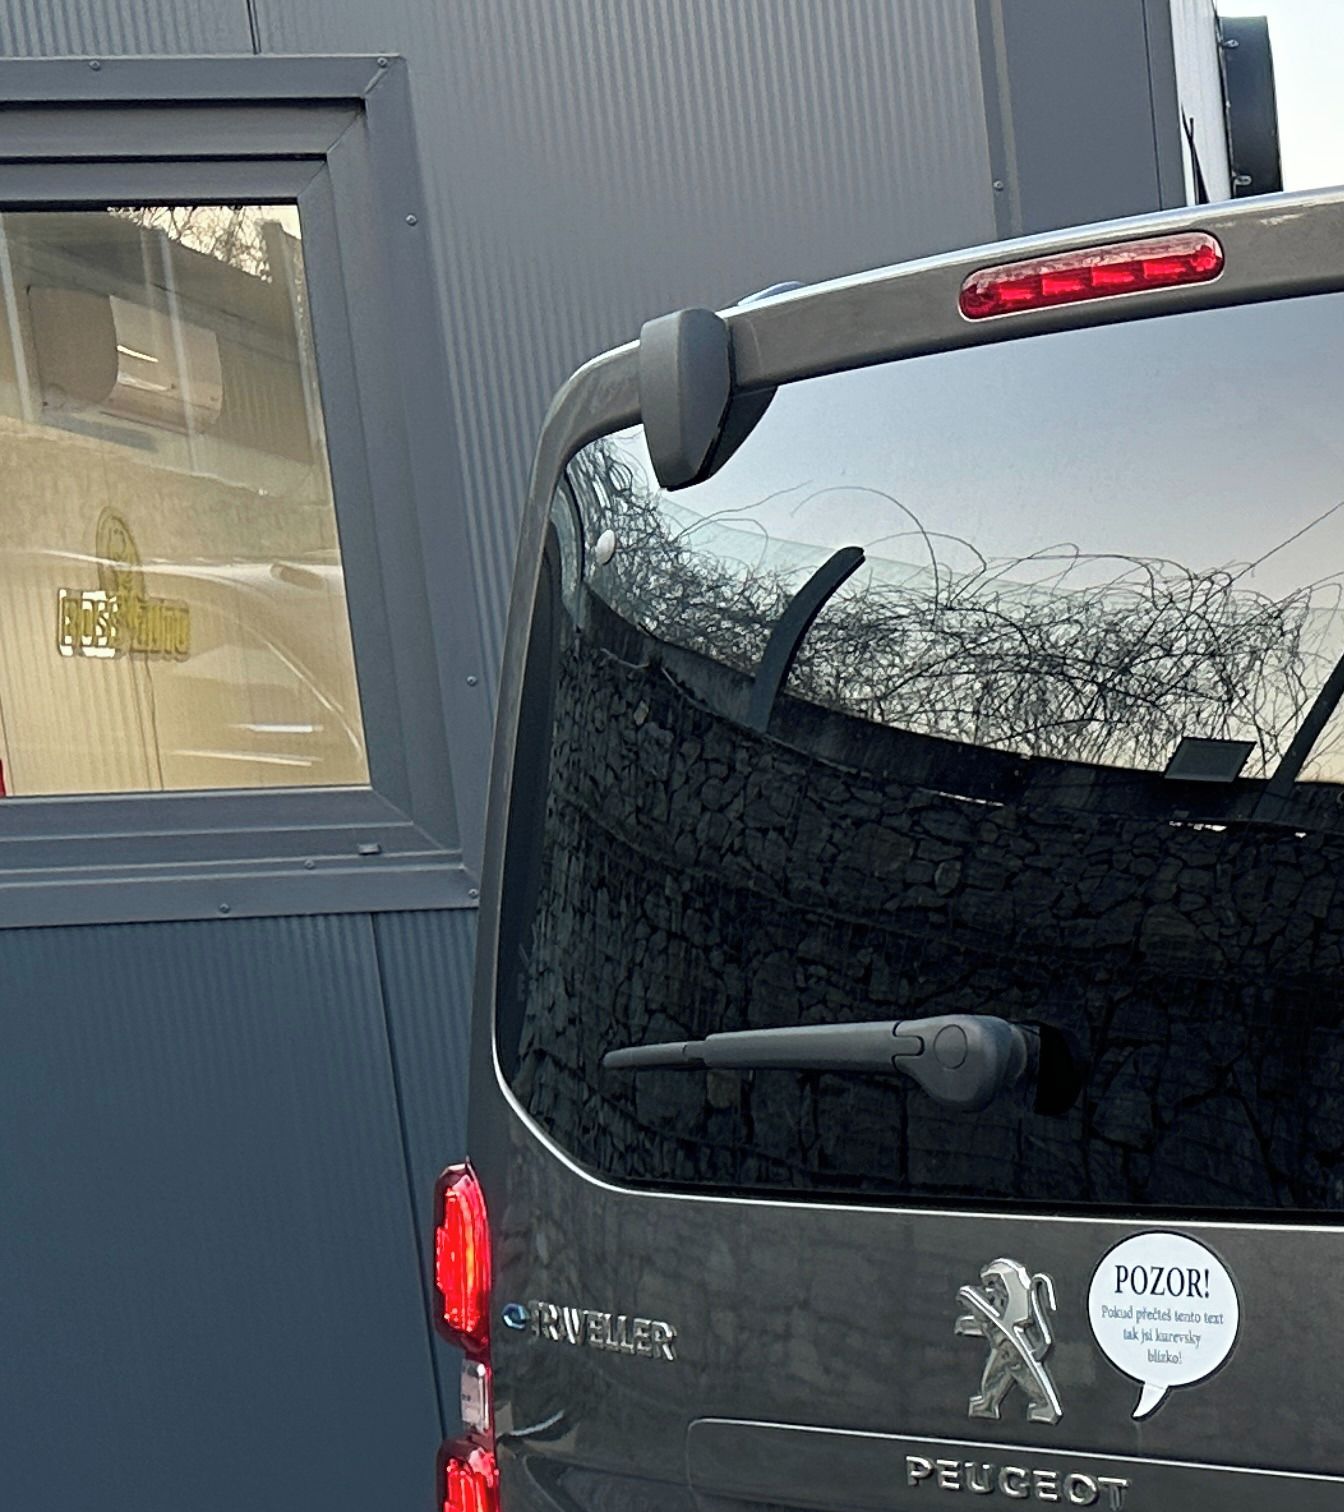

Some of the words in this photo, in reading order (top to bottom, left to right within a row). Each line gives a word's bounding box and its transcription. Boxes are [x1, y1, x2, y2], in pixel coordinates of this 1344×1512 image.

[1114, 1264, 1210, 1299] POZOR!
[1101, 1305, 1133, 1320] Pokud
[1174, 1311, 1201, 1324] tento
[1203, 1312, 1224, 1325] text
[1123, 1327, 1139, 1341] tak
[1140, 1329, 1153, 1345] jsi
[906, 1455, 1132, 1512] PEUGEOT
